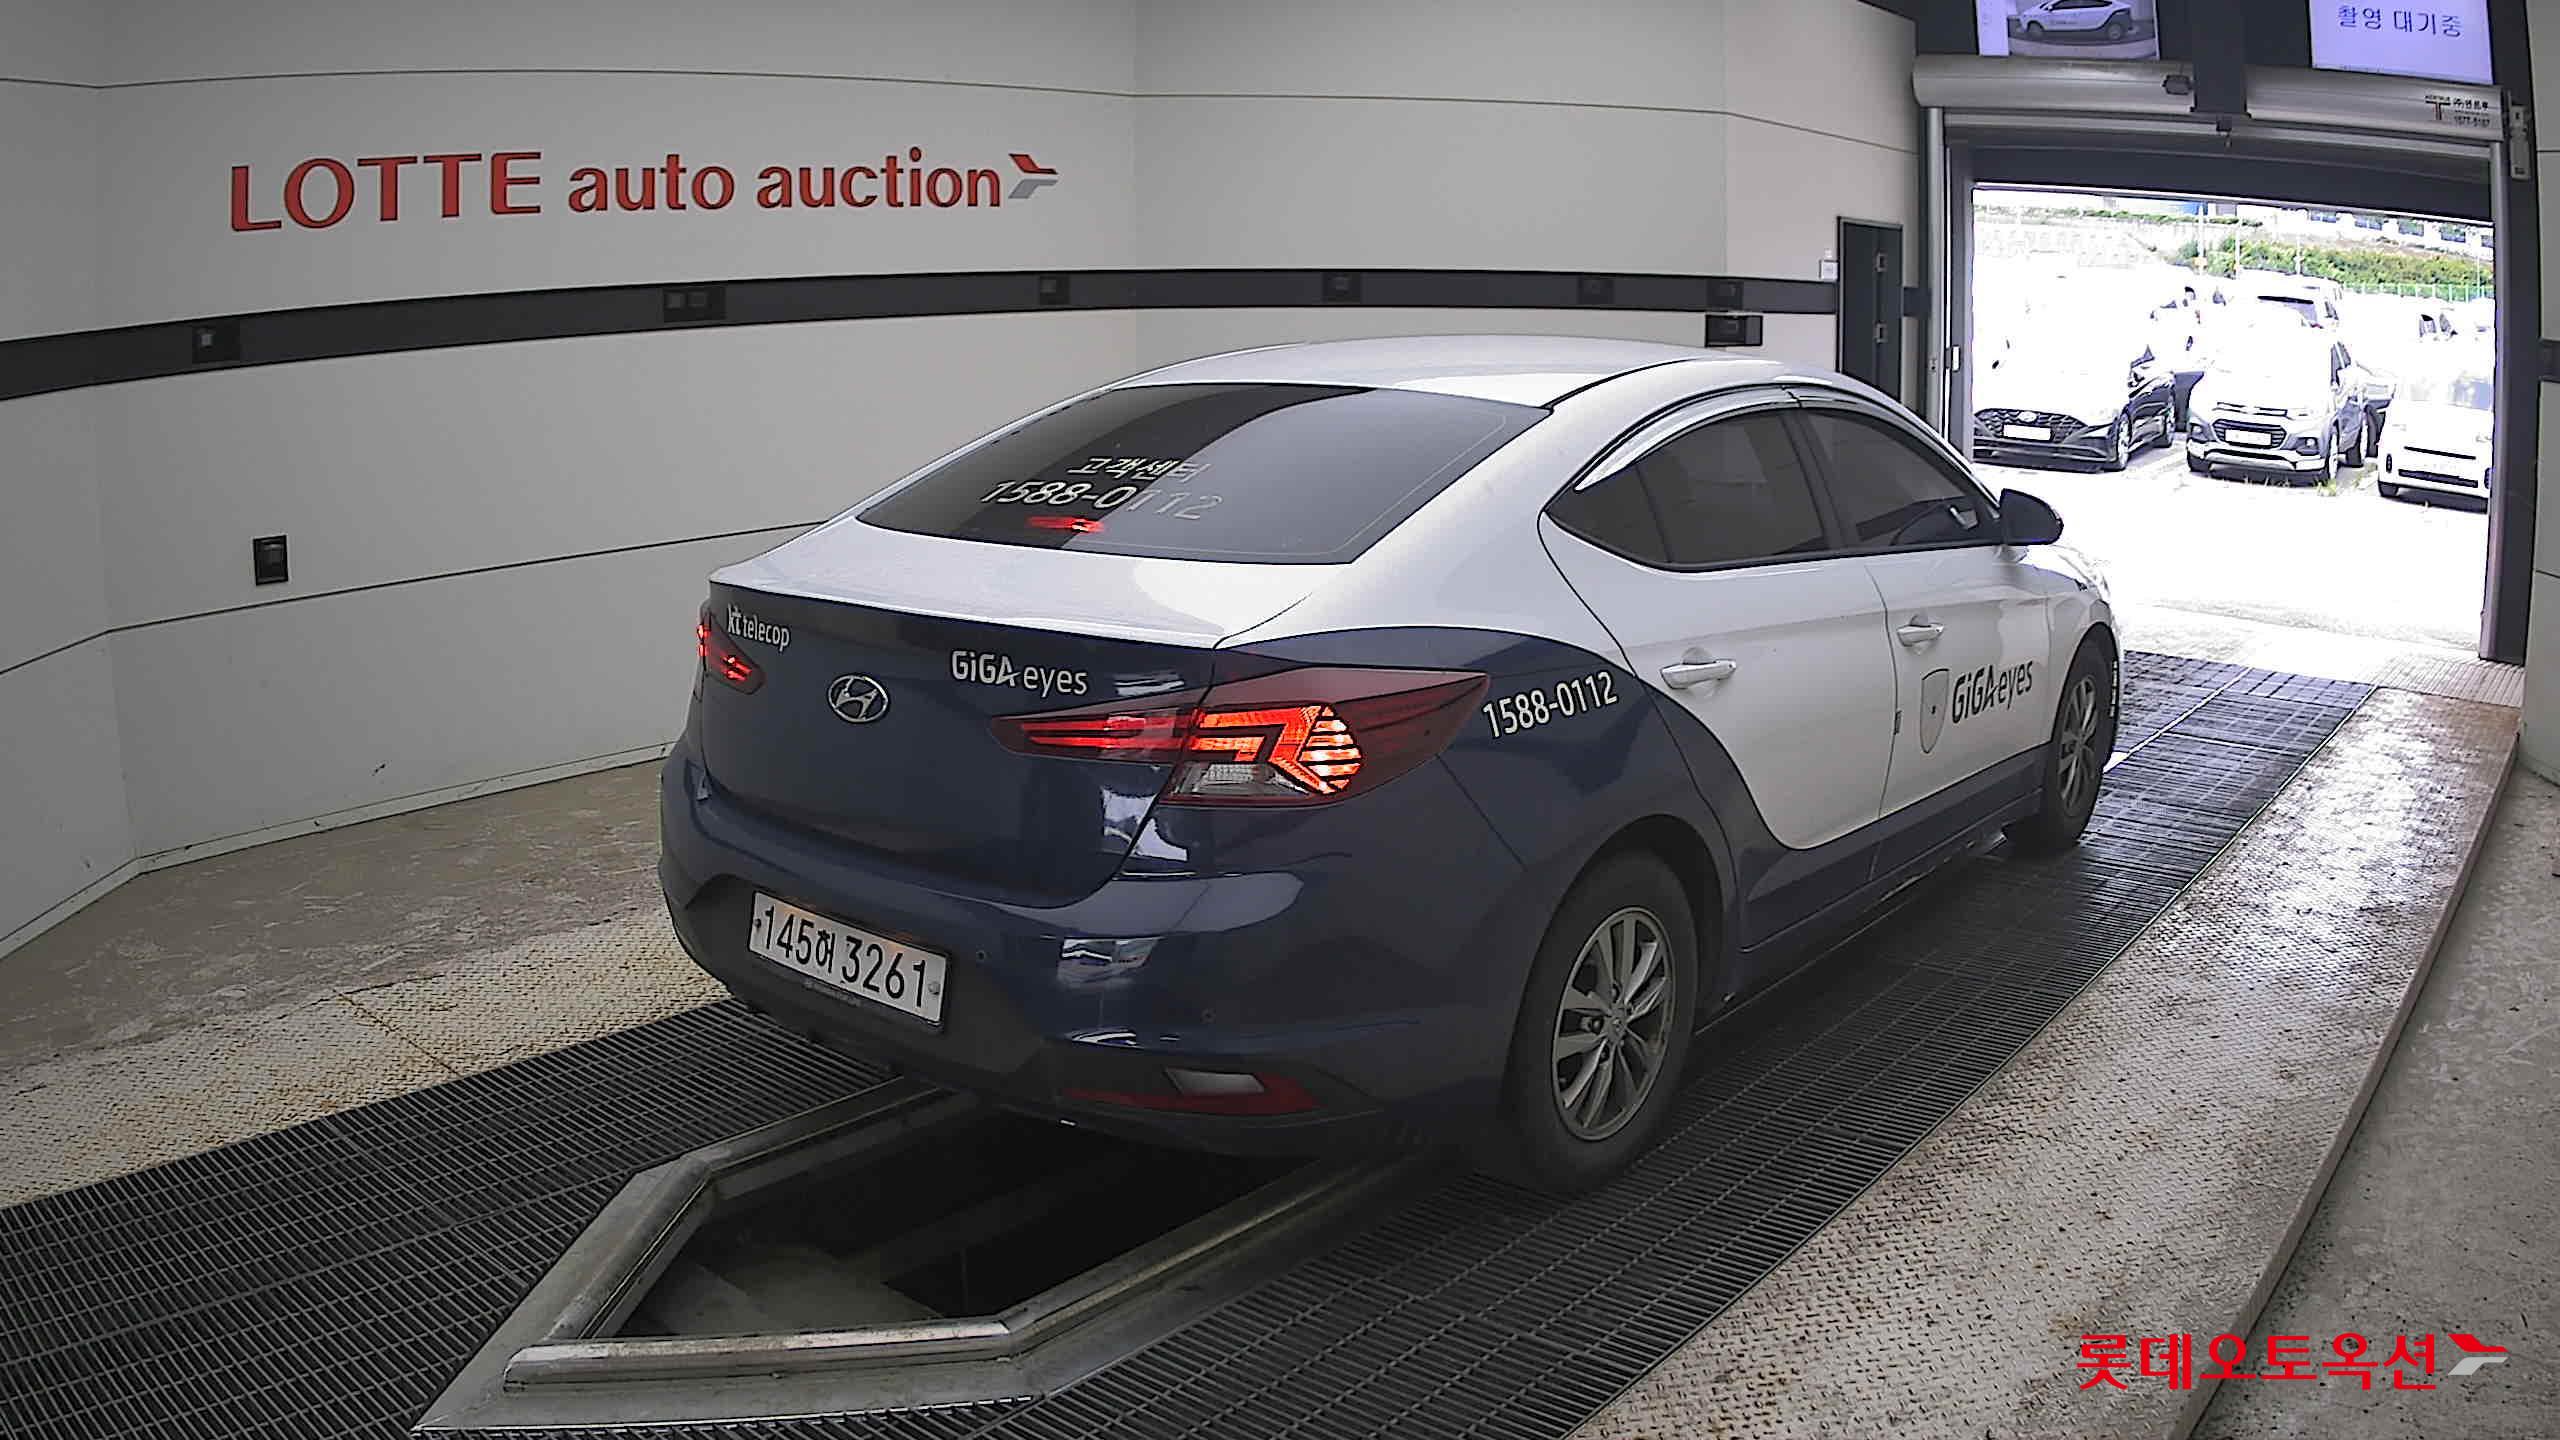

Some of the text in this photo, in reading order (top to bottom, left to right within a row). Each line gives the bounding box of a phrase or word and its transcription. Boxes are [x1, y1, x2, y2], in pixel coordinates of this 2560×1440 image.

[2338, 5, 2382, 30] 촬영
[231, 146, 1002, 232] LOTTE auto auction
[1066, 457, 1212, 484] 고객센터
[980, 481, 1224, 520] 1588-0112
[727, 602, 791, 653] kt telecop
[951, 650, 1089, 698] GiGA eyes
[1951, 660, 2033, 724] GiGA eyes
[1482, 671, 1619, 738] 1588-0112
[765, 905, 927, 1009] 145허 3261
